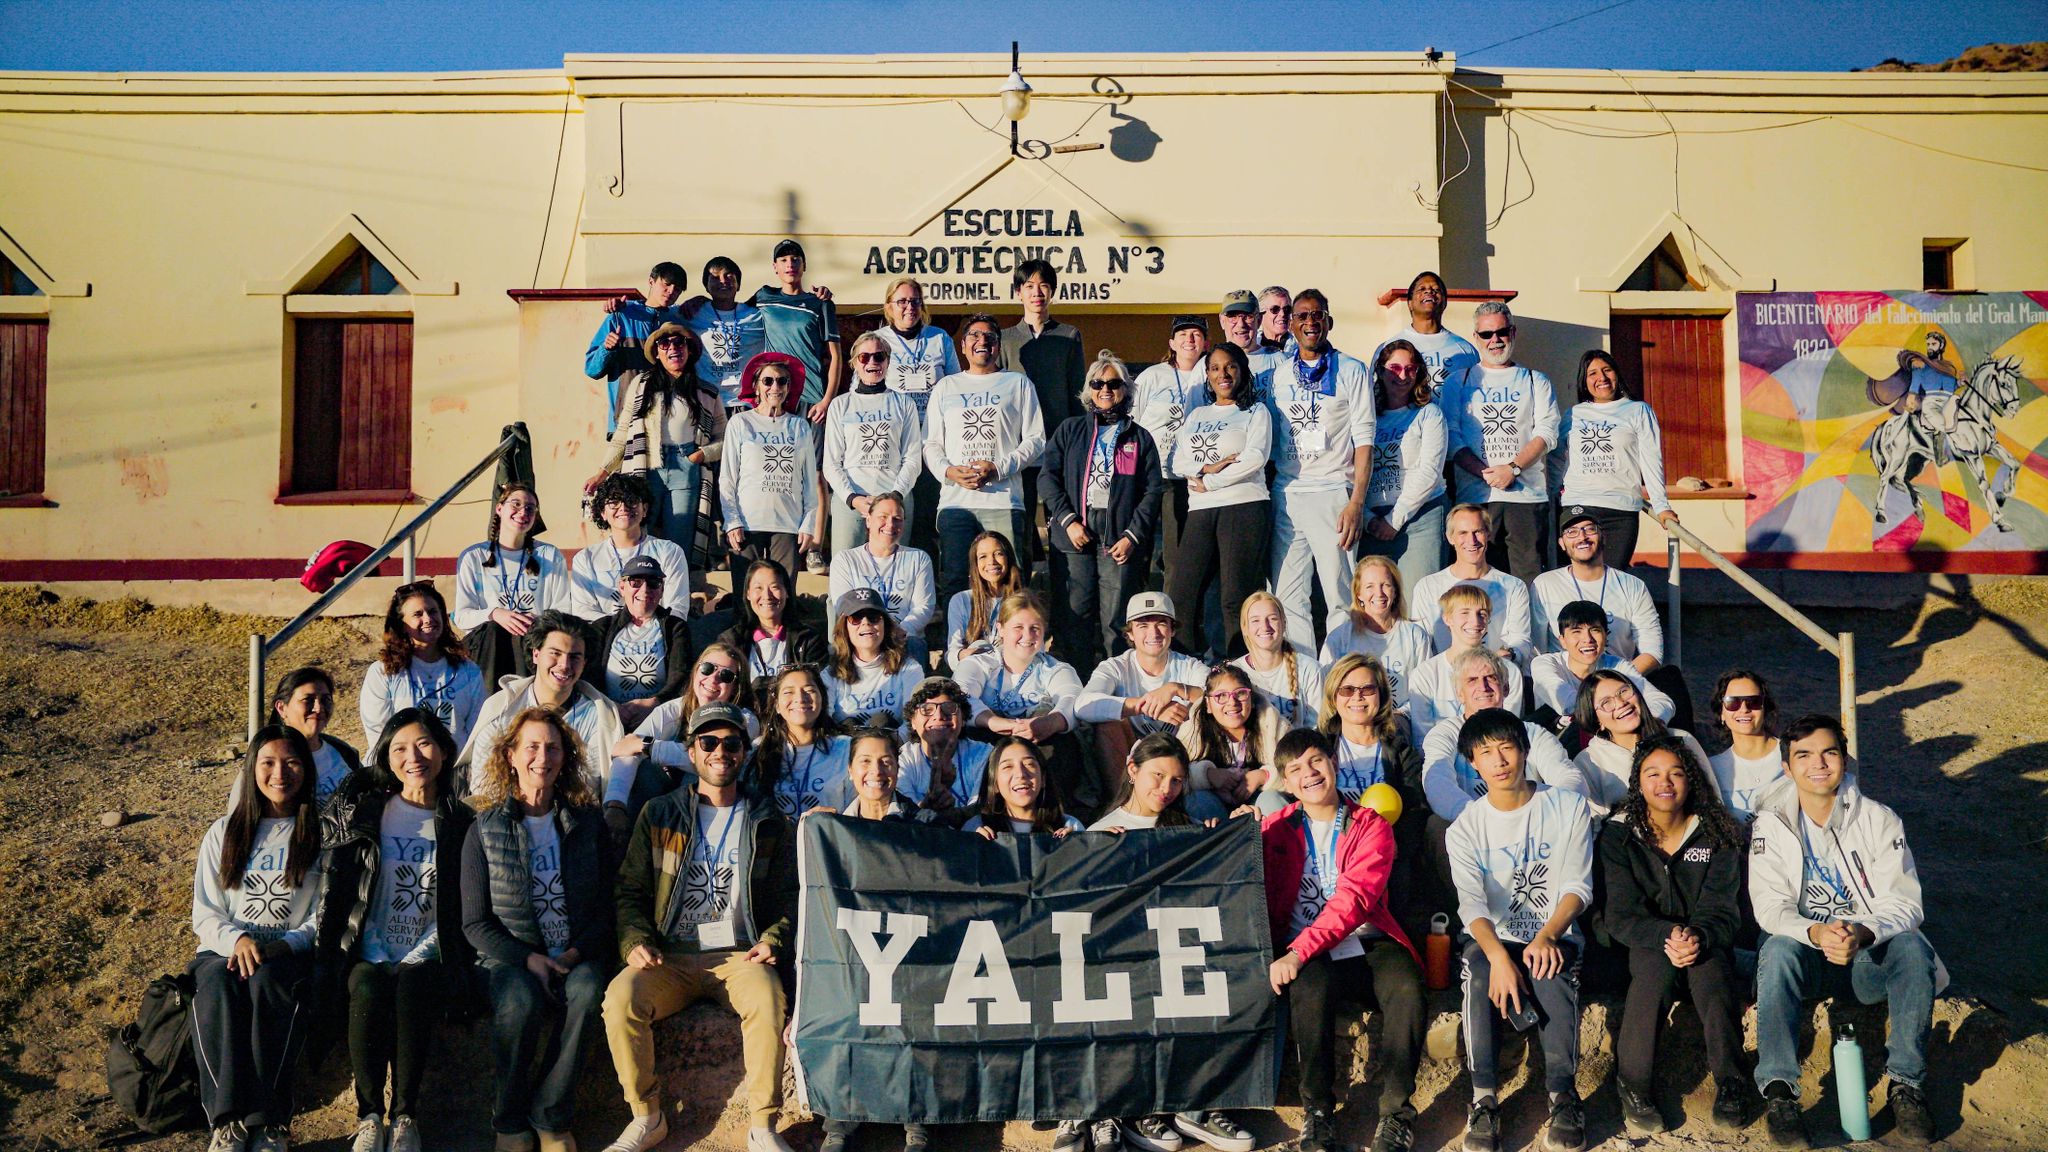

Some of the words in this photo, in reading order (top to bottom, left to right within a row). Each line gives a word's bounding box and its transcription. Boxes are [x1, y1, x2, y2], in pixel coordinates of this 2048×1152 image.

[944, 209, 1084, 237] ESCUELA
[1107, 246, 1165, 274] N°3
[1755, 303, 1858, 325] BICENTENARIO
[1864, 304, 1881, 324] del
[1887, 303, 1961, 324] Fallecimiento
[1966, 303, 1983, 324] del
[2019, 302, 2048, 323] Man
[1793, 339, 1831, 360] 1822
[892, 352, 932, 365] Yae
[960, 391, 1001, 408] Yale
[1289, 384, 1326, 401] Yae
[1475, 387, 1521, 403] Yale
[856, 410, 892, 423] Yale
[1194, 420, 1228, 433] Yale
[757, 431, 795, 445] Yale
[1481, 444, 1519, 452] SERVICE
[864, 575, 905, 592] Yale
[617, 641, 659, 655] Yale
[1386, 656, 1402, 673] le
[851, 690, 896, 710] Yale
[1279, 696, 1294, 715] le
[247, 847, 285, 871] Yal
[391, 837, 436, 864] Yal
[1804, 855, 1834, 881] Ya
[244, 922, 290, 931] ALUMNI
[389, 914, 426, 926] ALUM
[387, 926, 425, 936] SERVIC
[836, 906, 1231, 1027] YALE
